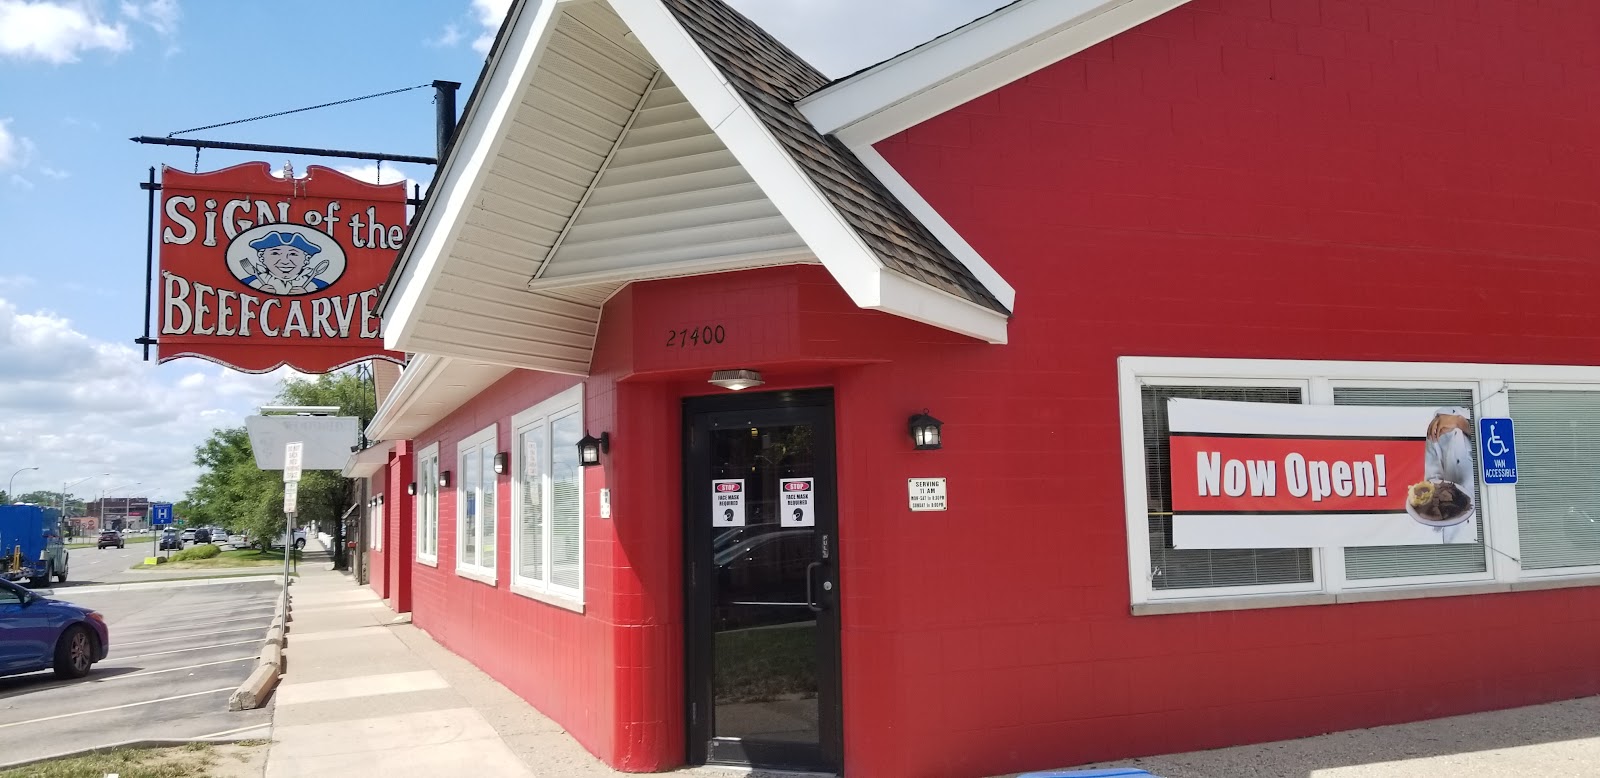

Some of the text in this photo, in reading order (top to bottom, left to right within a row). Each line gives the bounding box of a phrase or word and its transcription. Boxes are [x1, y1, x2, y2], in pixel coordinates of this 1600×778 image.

[303, 200, 342, 236] of
[348, 206, 404, 250] the
[161, 270, 385, 339] BEEFCARVE
[666, 325, 725, 348] 27400
[1486, 468, 1516, 478] ACCESSIBLE
[1493, 459, 1506, 468] VAN
[1196, 451, 1388, 502] Now Open!
[158, 508, 167, 519] H
